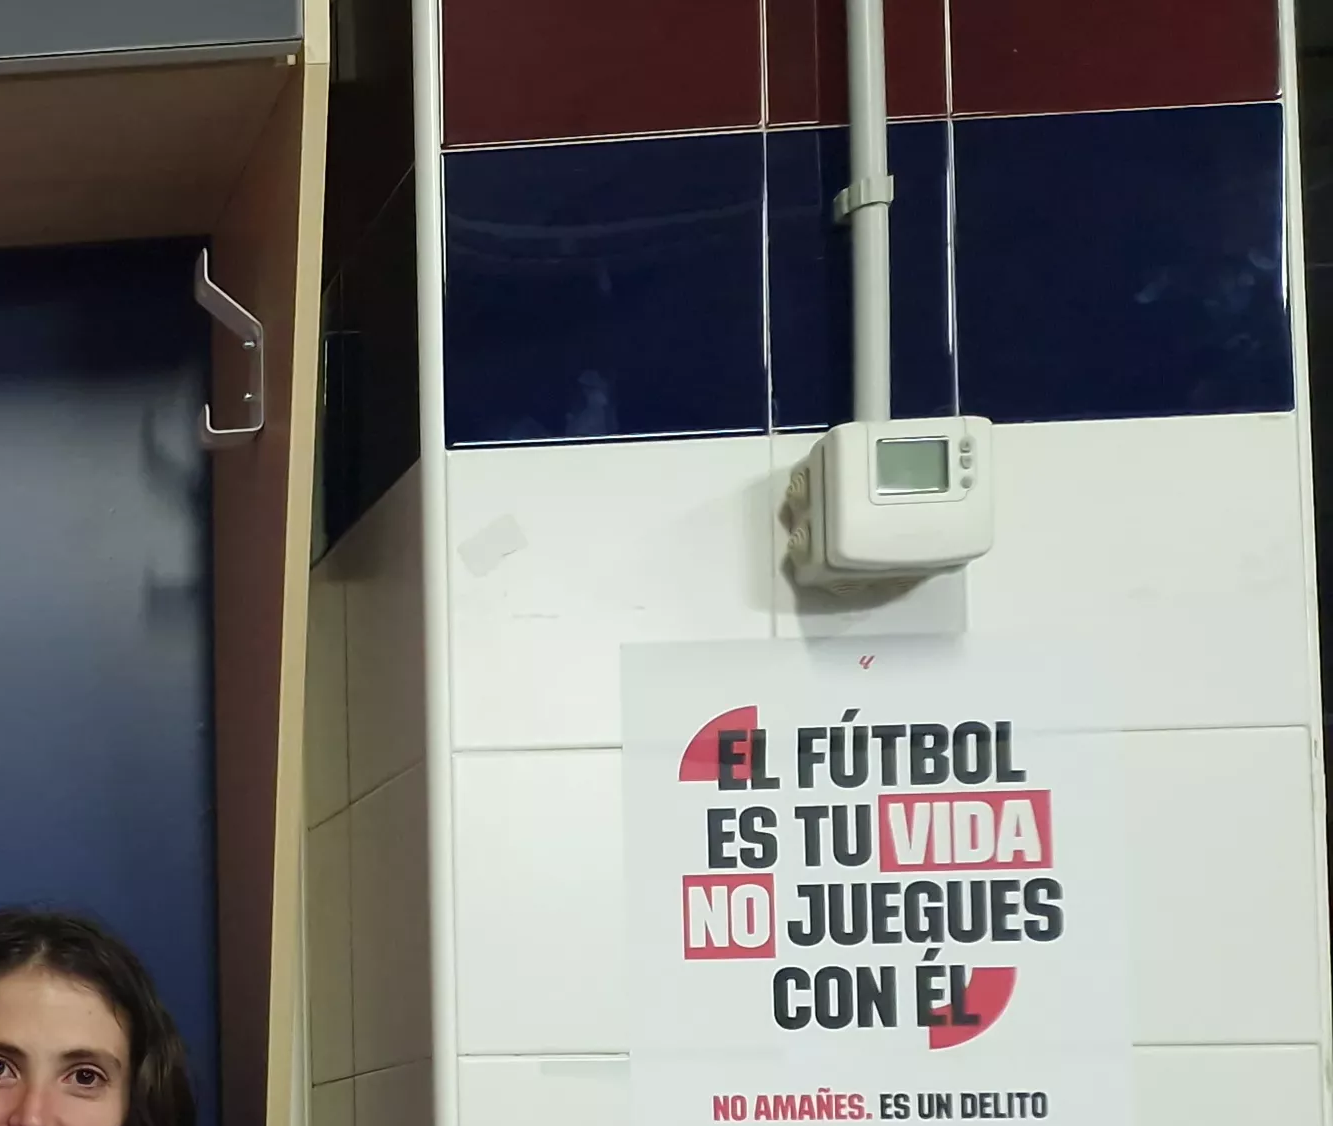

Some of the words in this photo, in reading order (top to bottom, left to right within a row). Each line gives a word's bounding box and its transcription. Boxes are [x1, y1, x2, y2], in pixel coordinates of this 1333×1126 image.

[718, 728, 781, 791] EL
[797, 707, 1027, 789] FÚTBOL
[706, 806, 778, 869] ES
[794, 804, 872, 867] TU
[887, 799, 1043, 866] VIDA
[688, 884, 771, 949] NO
[787, 878, 1065, 947] JUEGUES
[772, 965, 898, 1030] CON
[916, 947, 981, 1028] ÉL
[712, 1094, 747, 1121] NO
[754, 1088, 873, 1121] AMAÑES.
[879, 1093, 910, 1120] ES
[917, 1092, 953, 1119] UN
[960, 1091, 1049, 1119] DELITO
